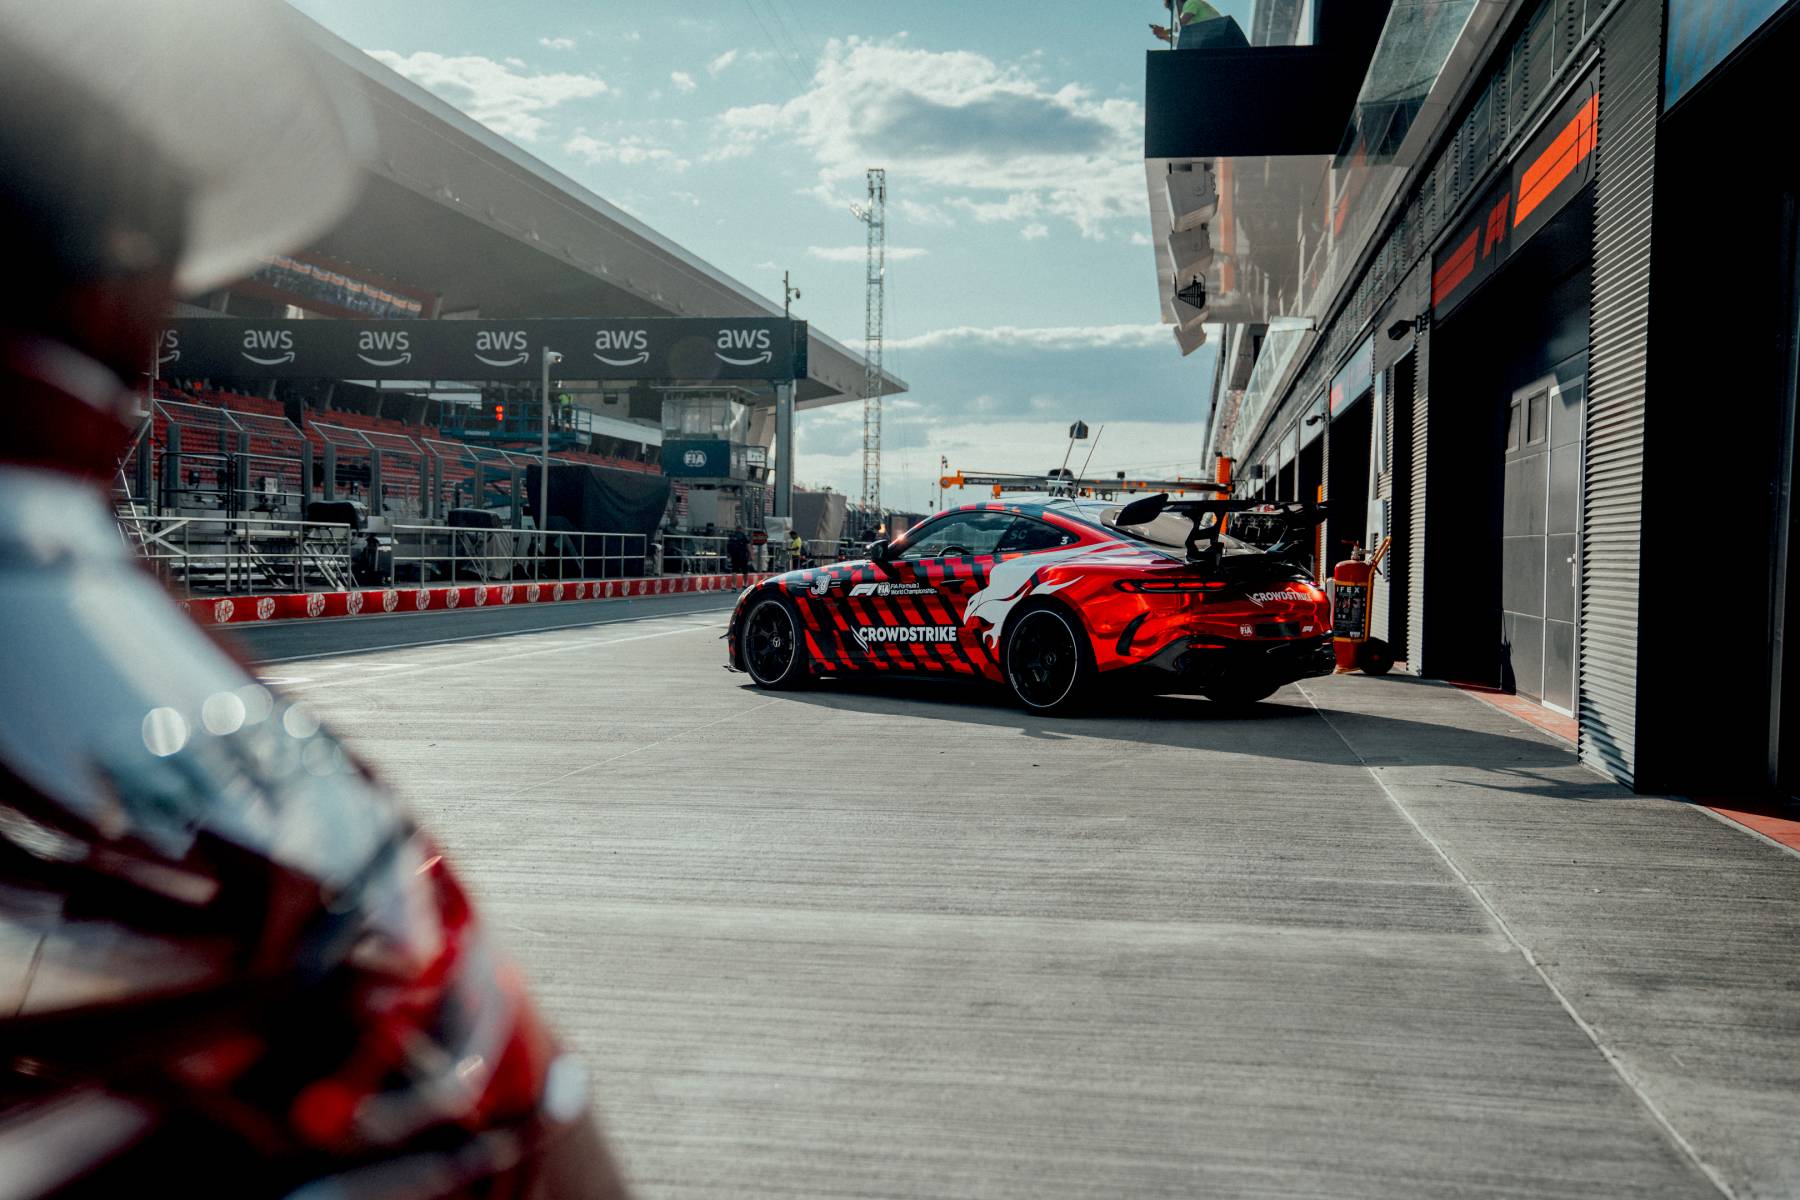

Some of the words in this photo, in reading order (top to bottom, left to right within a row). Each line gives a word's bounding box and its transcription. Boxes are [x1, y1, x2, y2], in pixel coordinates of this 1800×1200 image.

[244, 330, 293, 349] aws
[360, 331, 410, 350] aws
[476, 331, 527, 350] aws
[595, 330, 648, 349] aws
[717, 329, 771, 349] aws
[684, 454, 705, 464] FIA
[1010, 529, 1027, 540] SC
[849, 583, 878, 596] F1
[878, 584, 890, 594] FIA
[1252, 591, 1313, 602] CROWDSTRIKE
[859, 626, 957, 642] CROWDSTRIKE
[1239, 625, 1253, 635] FIA
